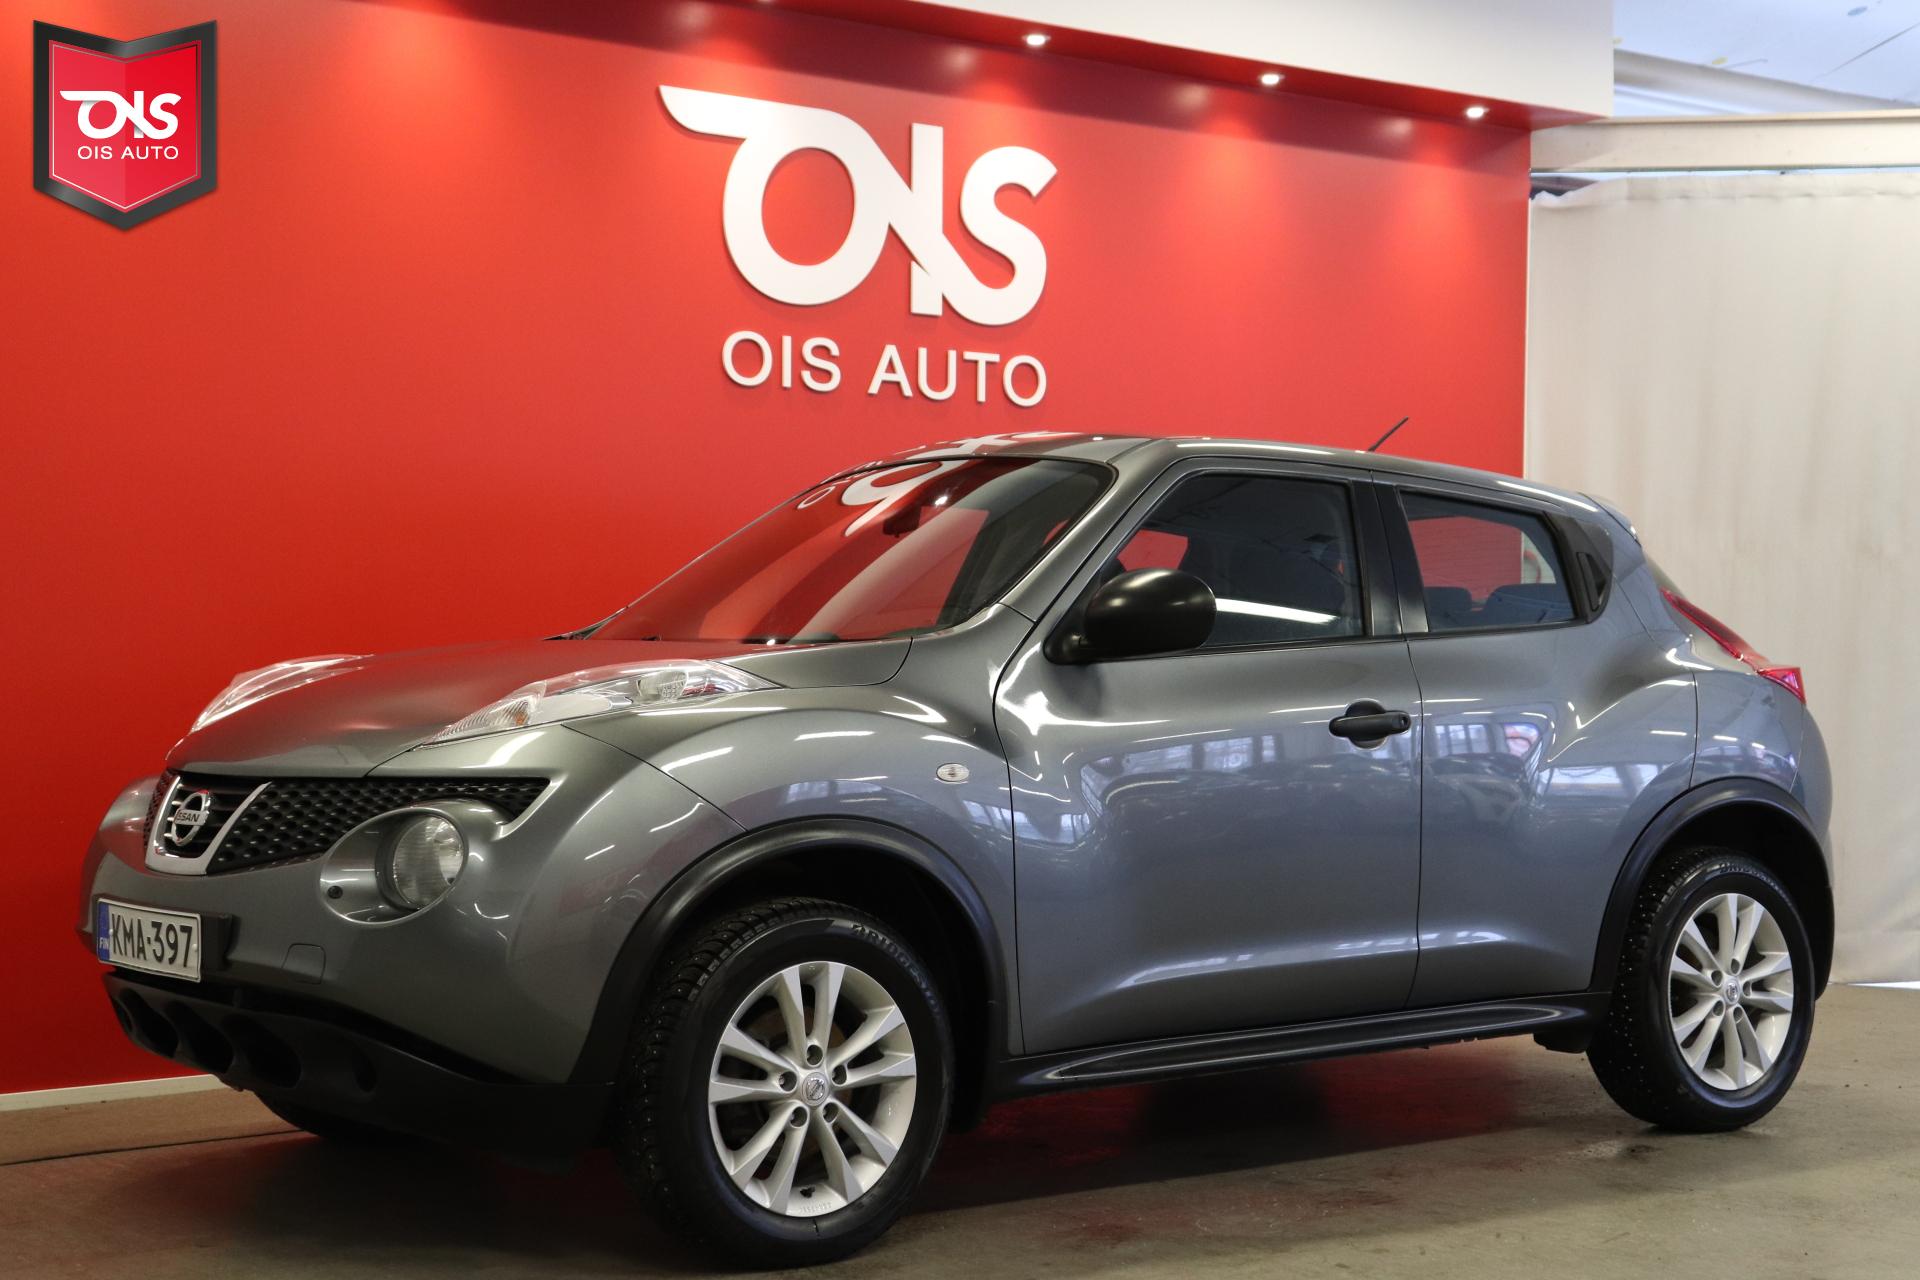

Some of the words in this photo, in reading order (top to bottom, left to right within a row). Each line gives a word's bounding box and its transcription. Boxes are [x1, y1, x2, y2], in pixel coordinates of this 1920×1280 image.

[659, 84, 1058, 325] OIS
[721, 330, 842, 392] OIS
[867, 344, 1048, 407] AUTO
[111, 913, 193, 967] KMA-397
